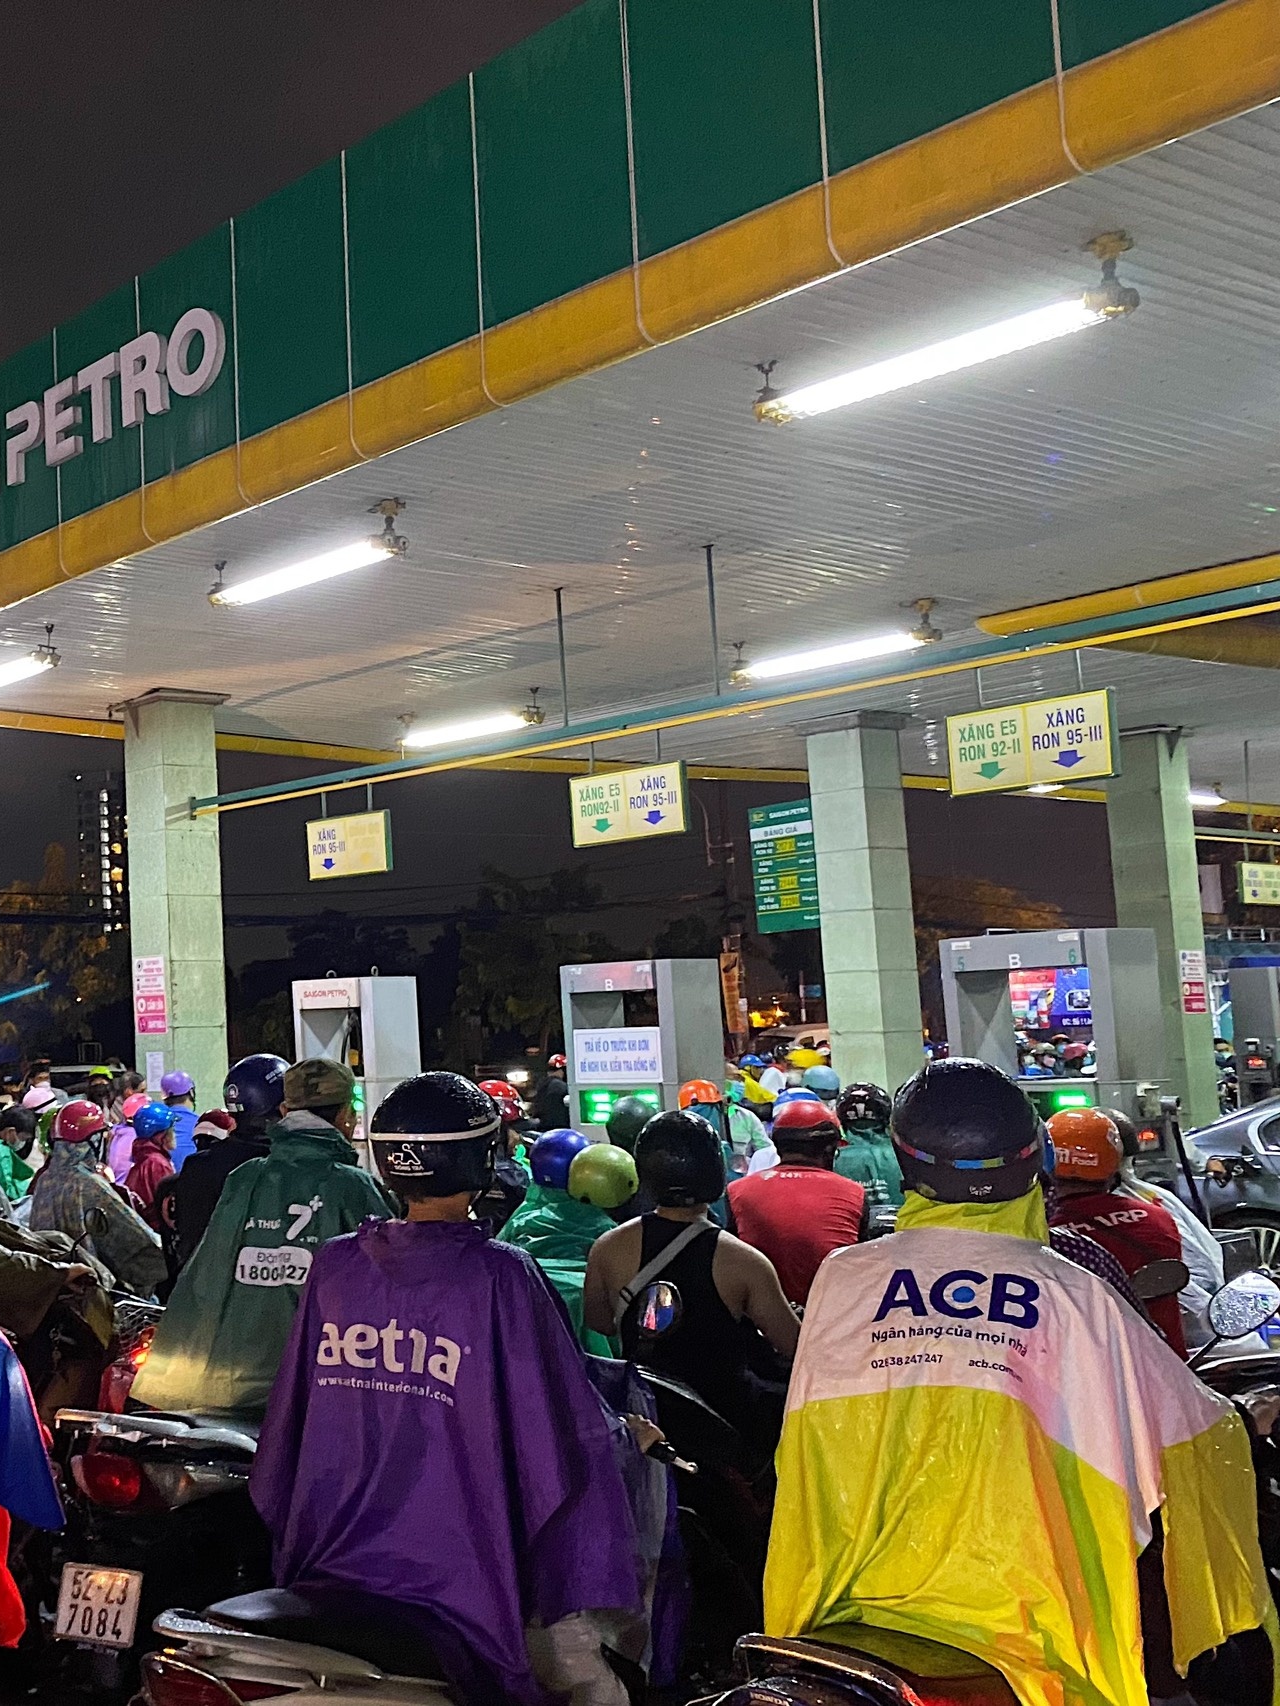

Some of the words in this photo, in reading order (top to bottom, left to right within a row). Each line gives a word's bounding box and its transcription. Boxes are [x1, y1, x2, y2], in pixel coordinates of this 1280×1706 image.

[6, 307, 226, 486] PETRO
[1046, 707, 1085, 729] XĂNG
[959, 722, 995, 743] XĂNG
[1000, 719, 1017, 736] E5
[1032, 732, 1061, 751] RON
[1066, 725, 1103, 746] 95-III
[959, 744, 986, 763] RON
[991, 738, 1021, 758] 92-II
[579, 785, 604, 802] XĂNG
[609, 783, 621, 797] E5
[640, 775, 666, 792] XĂNG
[629, 795, 649, 809] RON
[652, 791, 677, 807] 95-III
[317, 828, 336, 841] XĂNG
[764, 827, 784, 837] BẢNG
[785, 825, 798, 834] GIÁ
[312, 843, 327, 855] RON
[328, 841, 346, 853] 95-III
[957, 956, 965, 971] 5
[1008, 954, 1021, 968] B
[1068, 949, 1077, 963] 6
[303, 990, 326, 998] SAIGON
[327, 989, 348, 997] PETRO
[605, 979, 614, 990] B
[871, 1269, 1040, 1330] ACB
[871, 1327, 906, 1343] Ngân
[909, 1326, 944, 1339] hàng
[945, 1325, 972, 1339] của
[975, 1332, 1005, 1346] mọi
[317, 1318, 461, 1387] aetna
[65, 1603, 122, 1640] 7084
